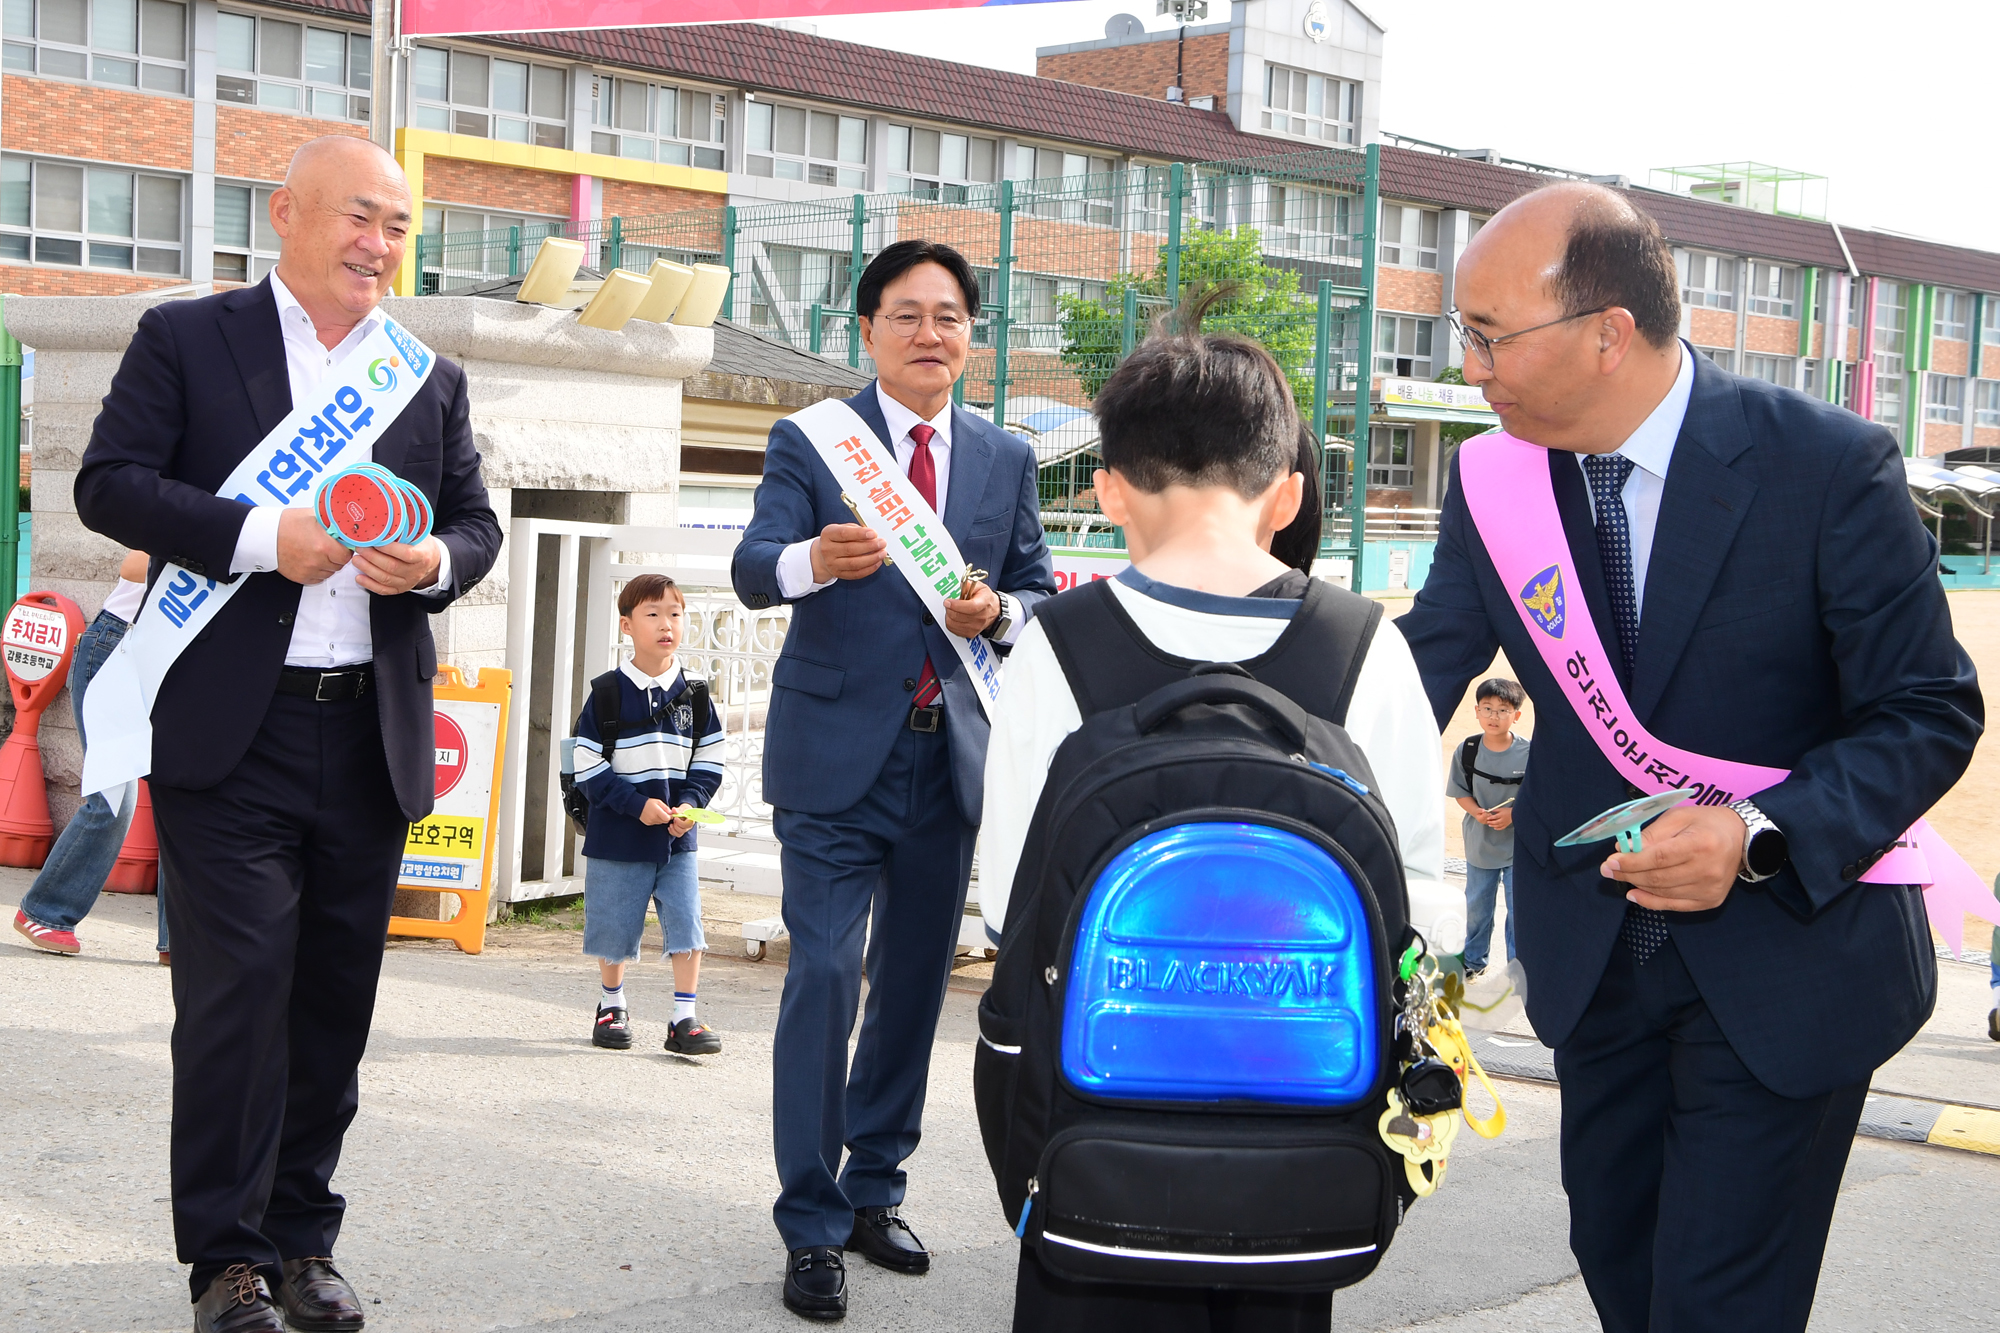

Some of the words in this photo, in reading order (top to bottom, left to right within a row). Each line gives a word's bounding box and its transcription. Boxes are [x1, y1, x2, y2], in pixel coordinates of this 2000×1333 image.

[389, 326, 422, 371] 교육지원청
[256, 386, 374, 505] 안전한
[867, 480, 915, 532] 살피고
[899, 523, 948, 578] 나부터
[11, 618, 62, 648] 주차금지
[1546, 613, 1564, 633] POLICE
[8, 650, 54, 669] 갑룡초등학교
[408, 823, 474, 849] 보호구역
[1107, 956, 1338, 997] BLACKYAK
